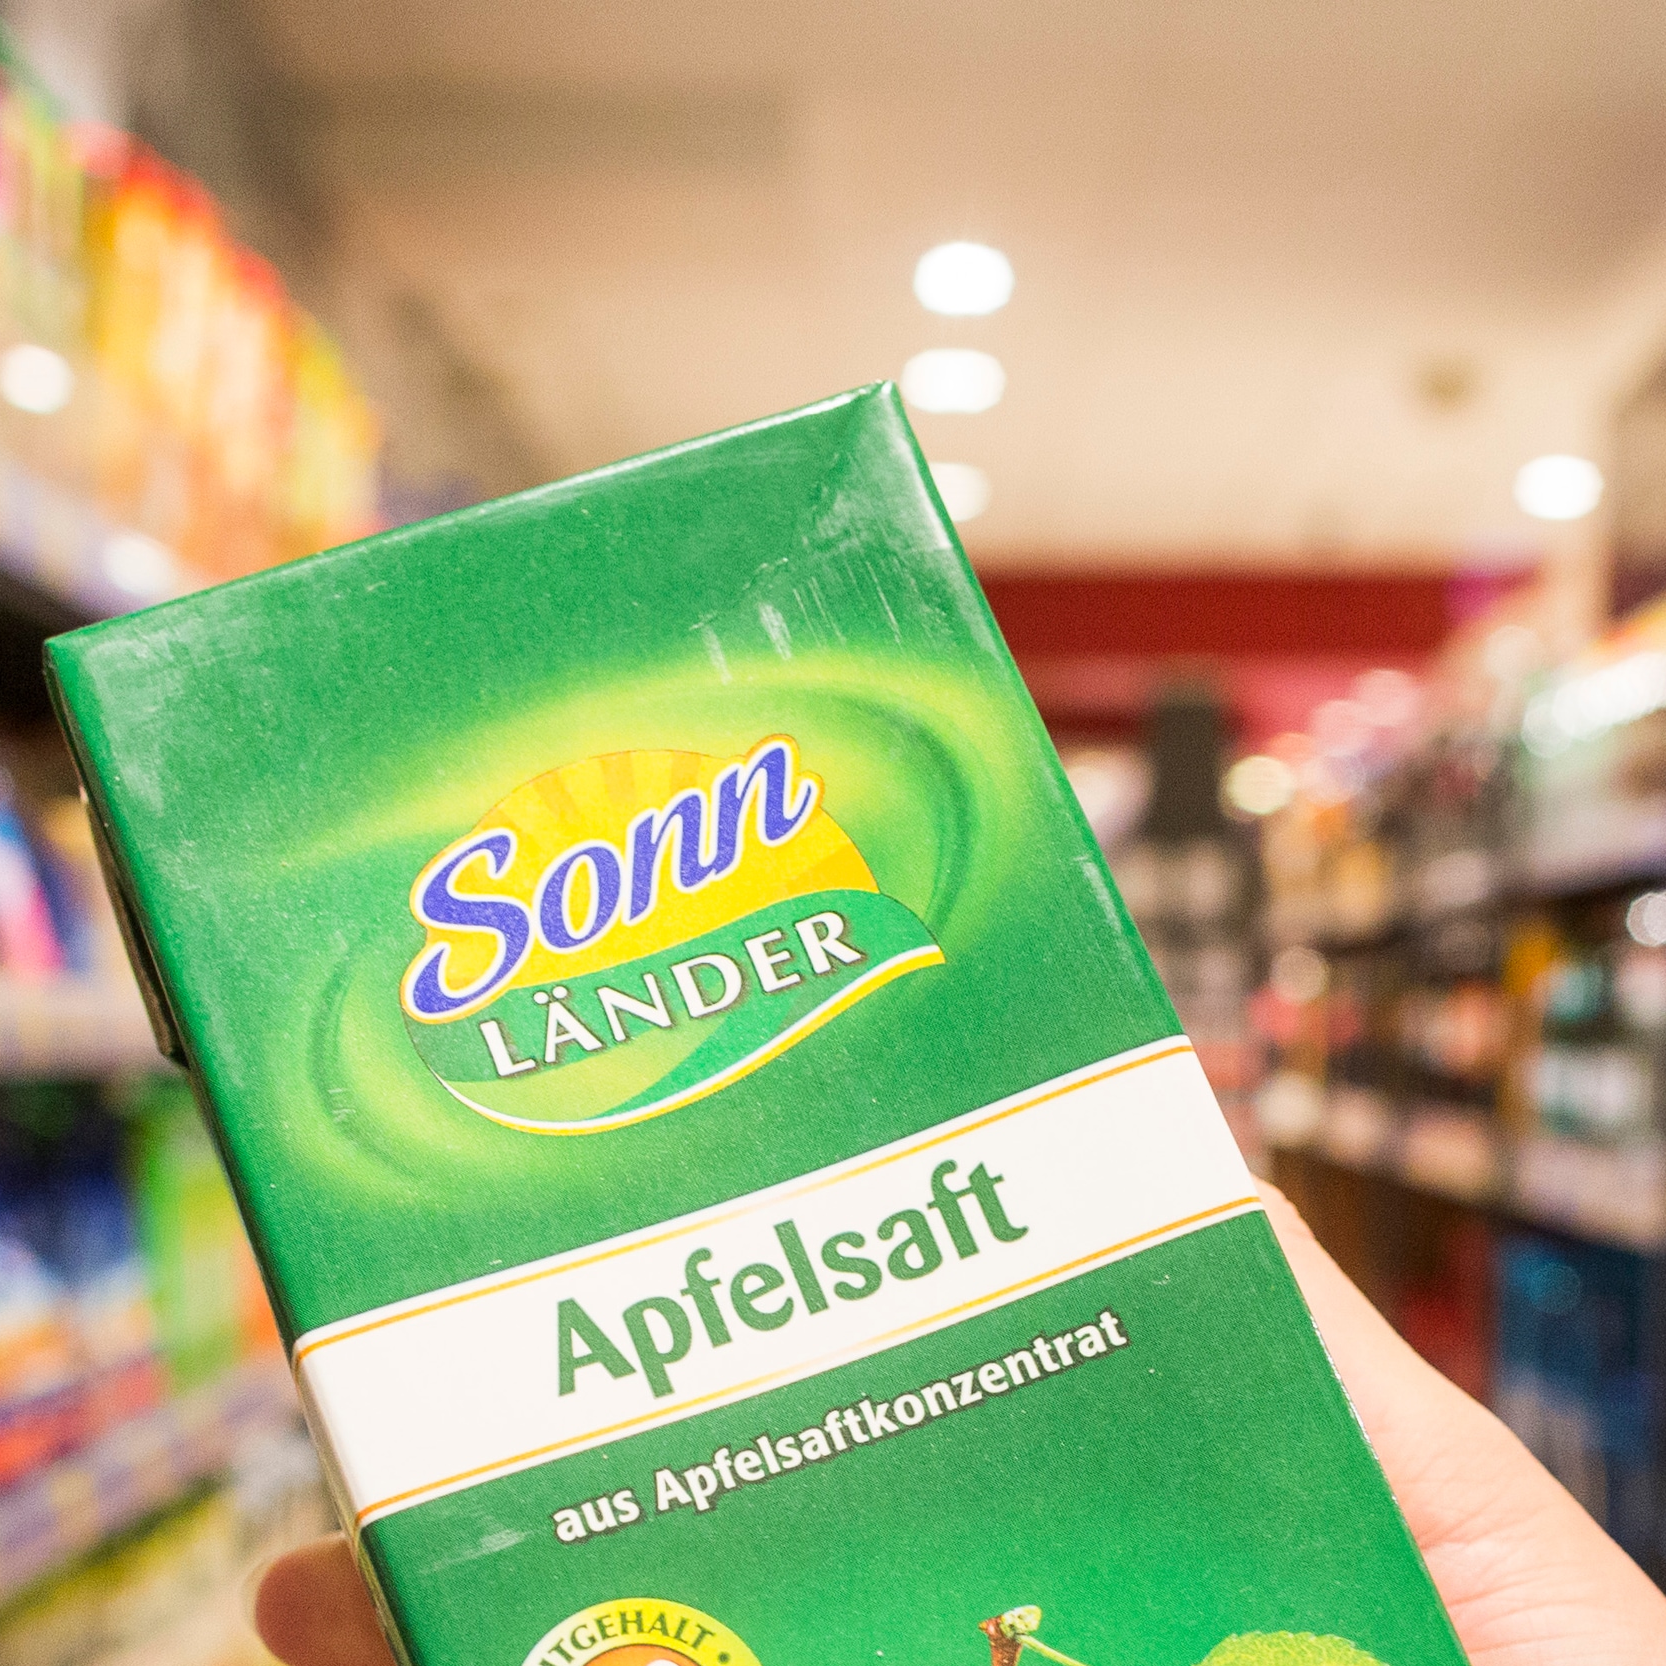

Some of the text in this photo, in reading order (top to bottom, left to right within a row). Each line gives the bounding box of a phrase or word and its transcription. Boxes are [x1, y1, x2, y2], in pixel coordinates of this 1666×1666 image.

[408, 739, 818, 1017] Sonn
[479, 909, 864, 1079] LÄNDER
[556, 1158, 1030, 1400] Apfelsaft
[551, 1308, 1130, 1544] aus Apfelsaftkonzentrat
